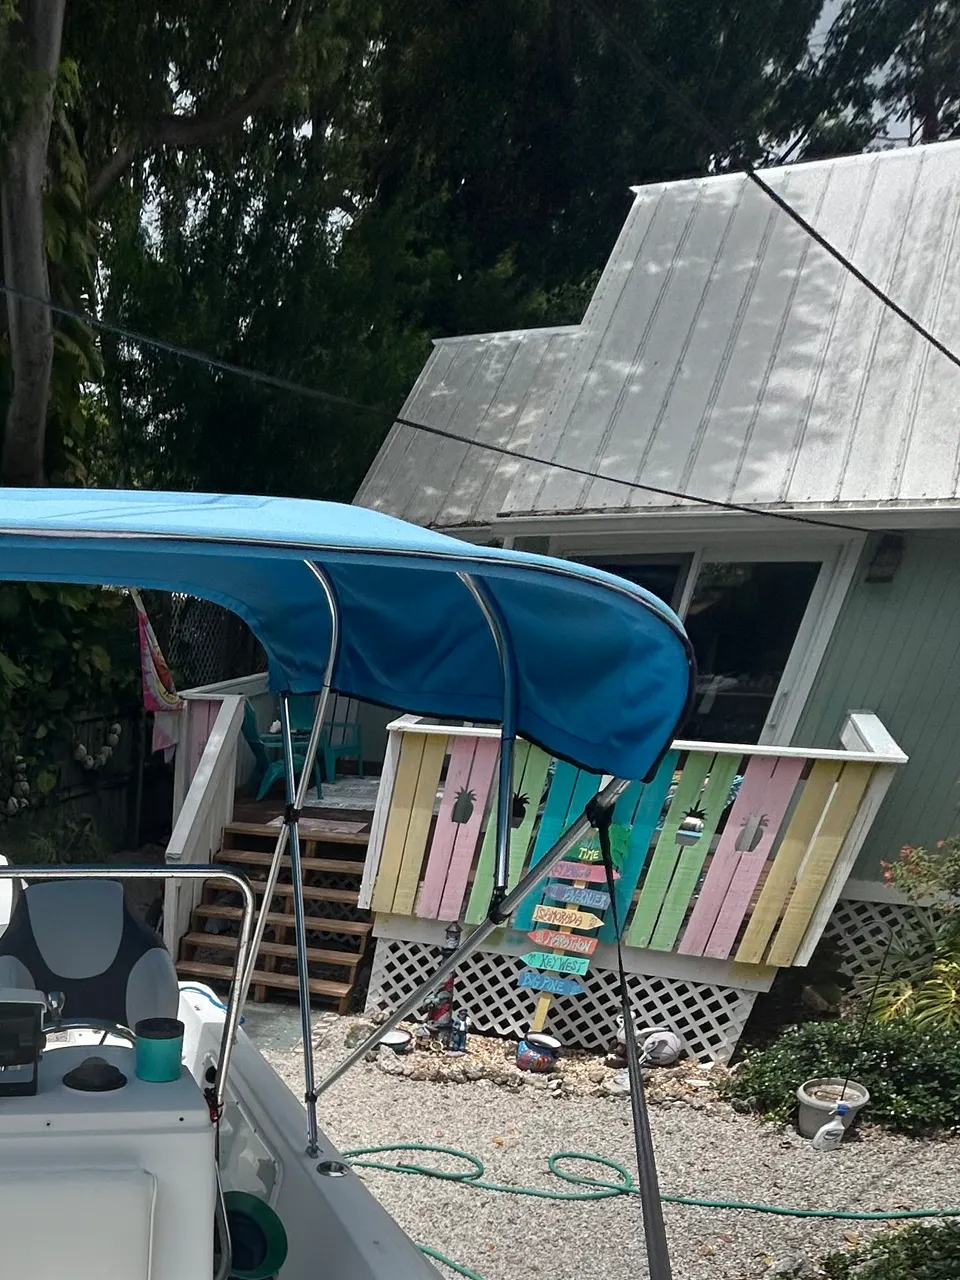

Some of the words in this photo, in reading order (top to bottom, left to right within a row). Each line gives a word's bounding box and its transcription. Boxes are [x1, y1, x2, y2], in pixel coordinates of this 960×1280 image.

[546, 931, 593, 953] MARATHON
[540, 954, 557, 969] KEY
[559, 957, 586, 974] WEST
